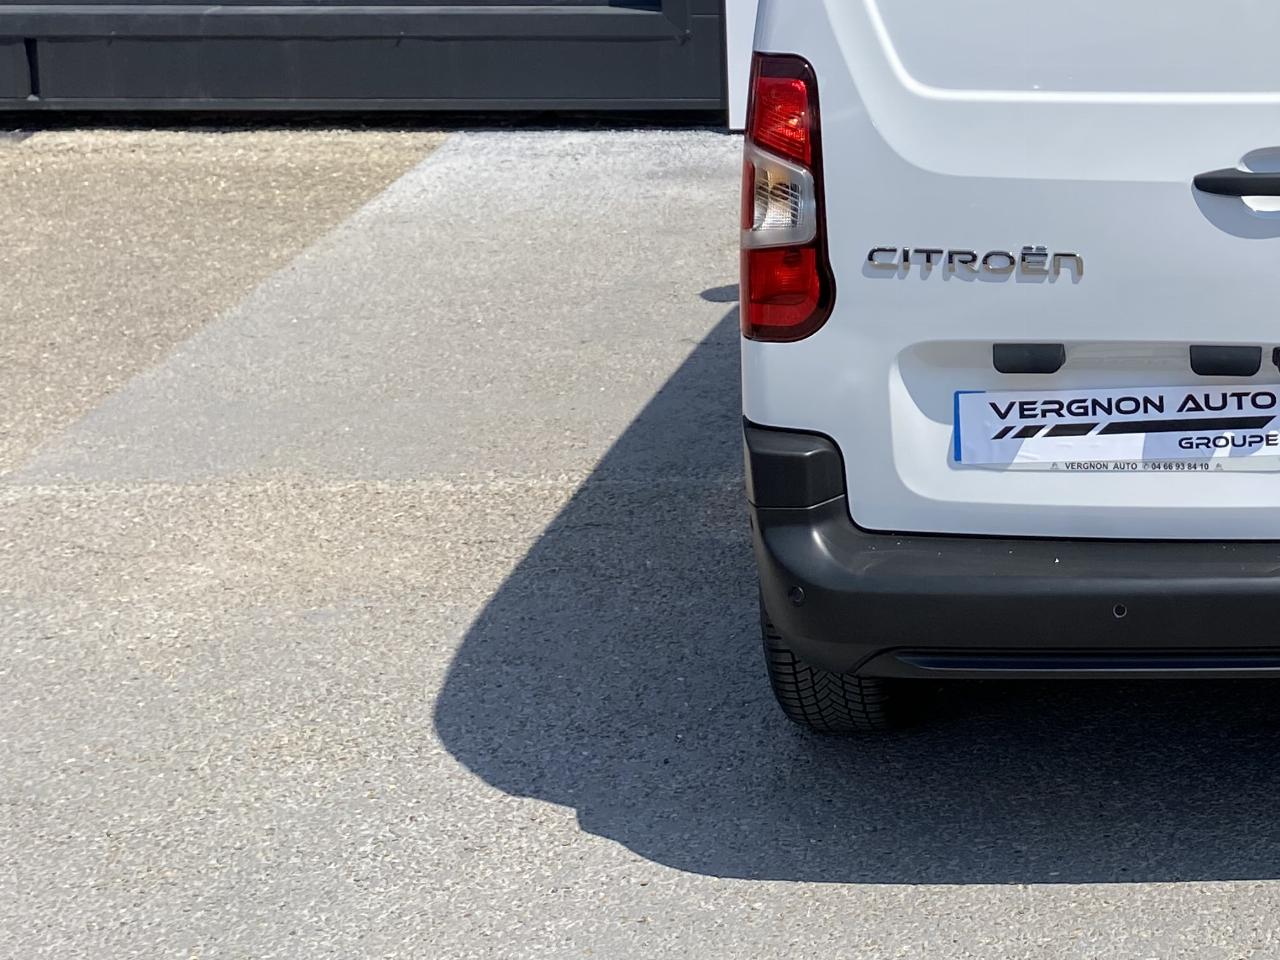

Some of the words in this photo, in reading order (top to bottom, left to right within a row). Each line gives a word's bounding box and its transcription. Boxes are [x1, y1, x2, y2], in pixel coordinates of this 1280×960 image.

[866, 244, 1084, 278] CITROËN
[989, 395, 1165, 420] VERGNON
[1176, 391, 1278, 413] AUTO
[1178, 433, 1280, 450] GROUPE
[1065, 462, 1109, 470] VERGNON
[1113, 462, 1138, 470] AUTO
[1151, 462, 1161, 470] 04
[1163, 462, 1173, 470] 66
[1175, 462, 1185, 470] 93
[1187, 462, 1198, 470] 84
[1199, 462, 1209, 470] 10
